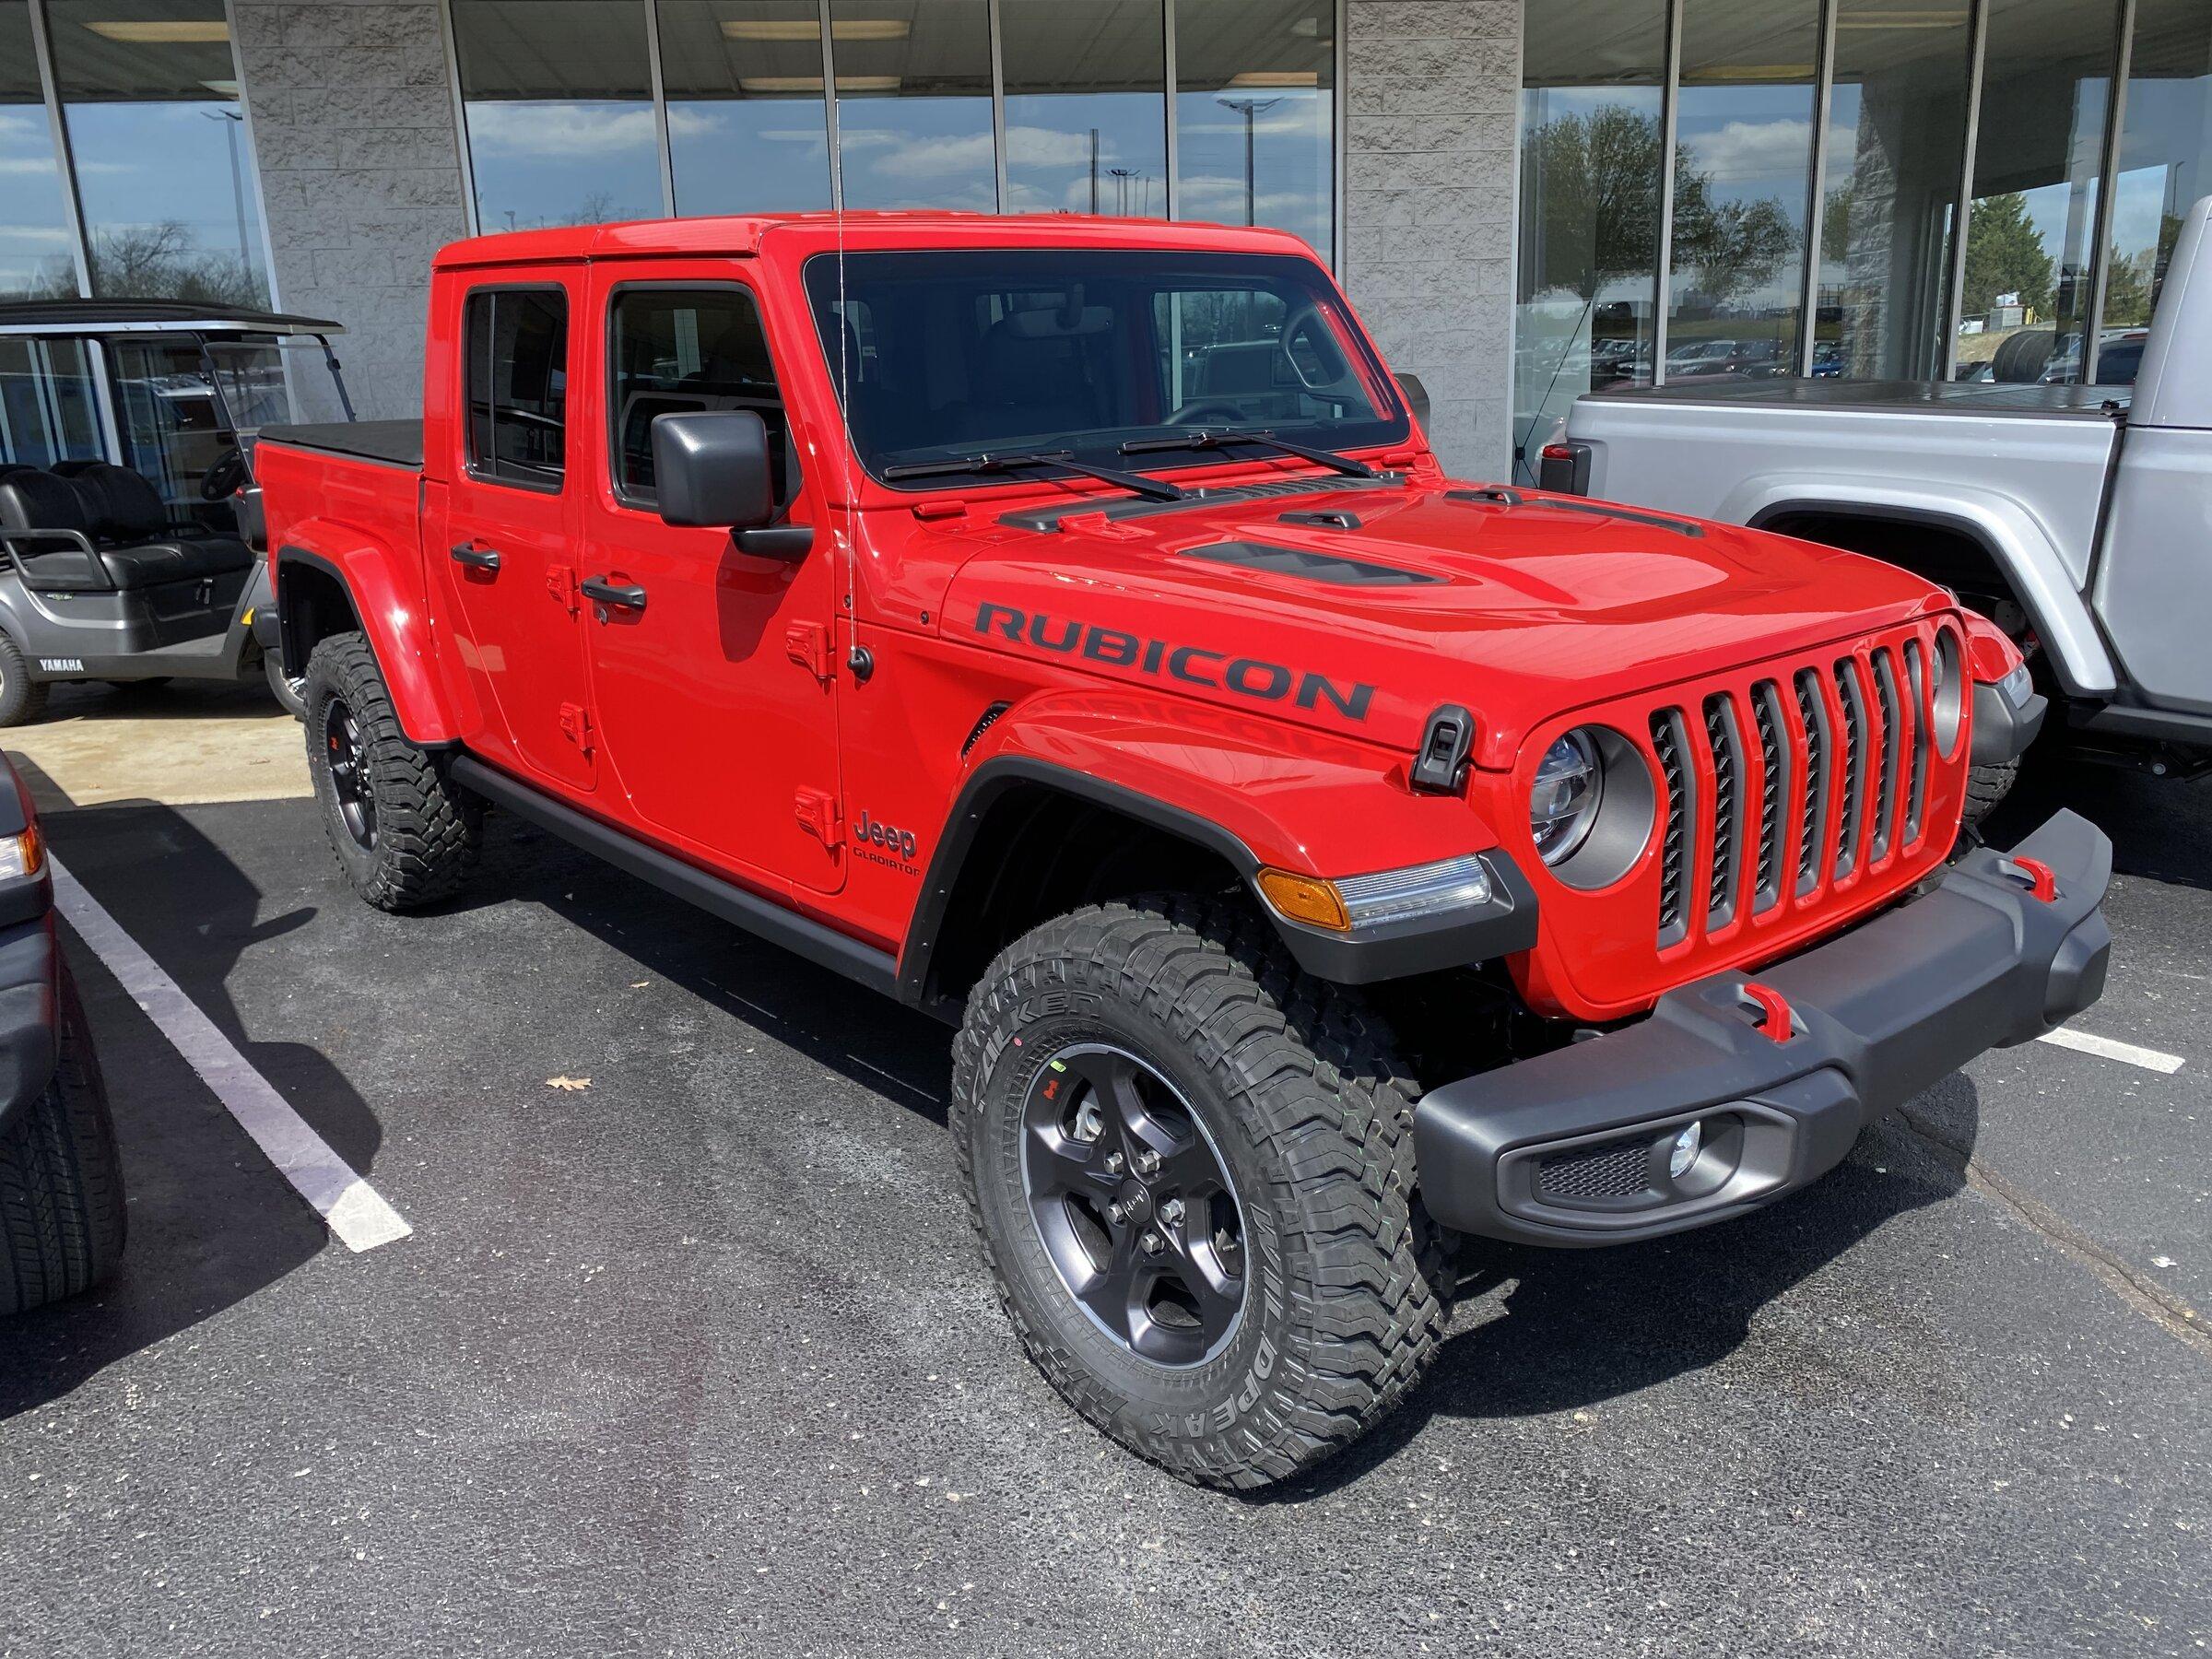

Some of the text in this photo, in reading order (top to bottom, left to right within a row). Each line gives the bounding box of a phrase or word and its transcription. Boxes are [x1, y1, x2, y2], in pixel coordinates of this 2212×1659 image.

[40, 658, 85, 672] YAMAHA
[974, 601, 1378, 722] RUBICON
[853, 809, 916, 862] Jeep
[853, 846, 921, 877] GLADIATOR
[1148, 1202, 1285, 1440] WILDPEAK
